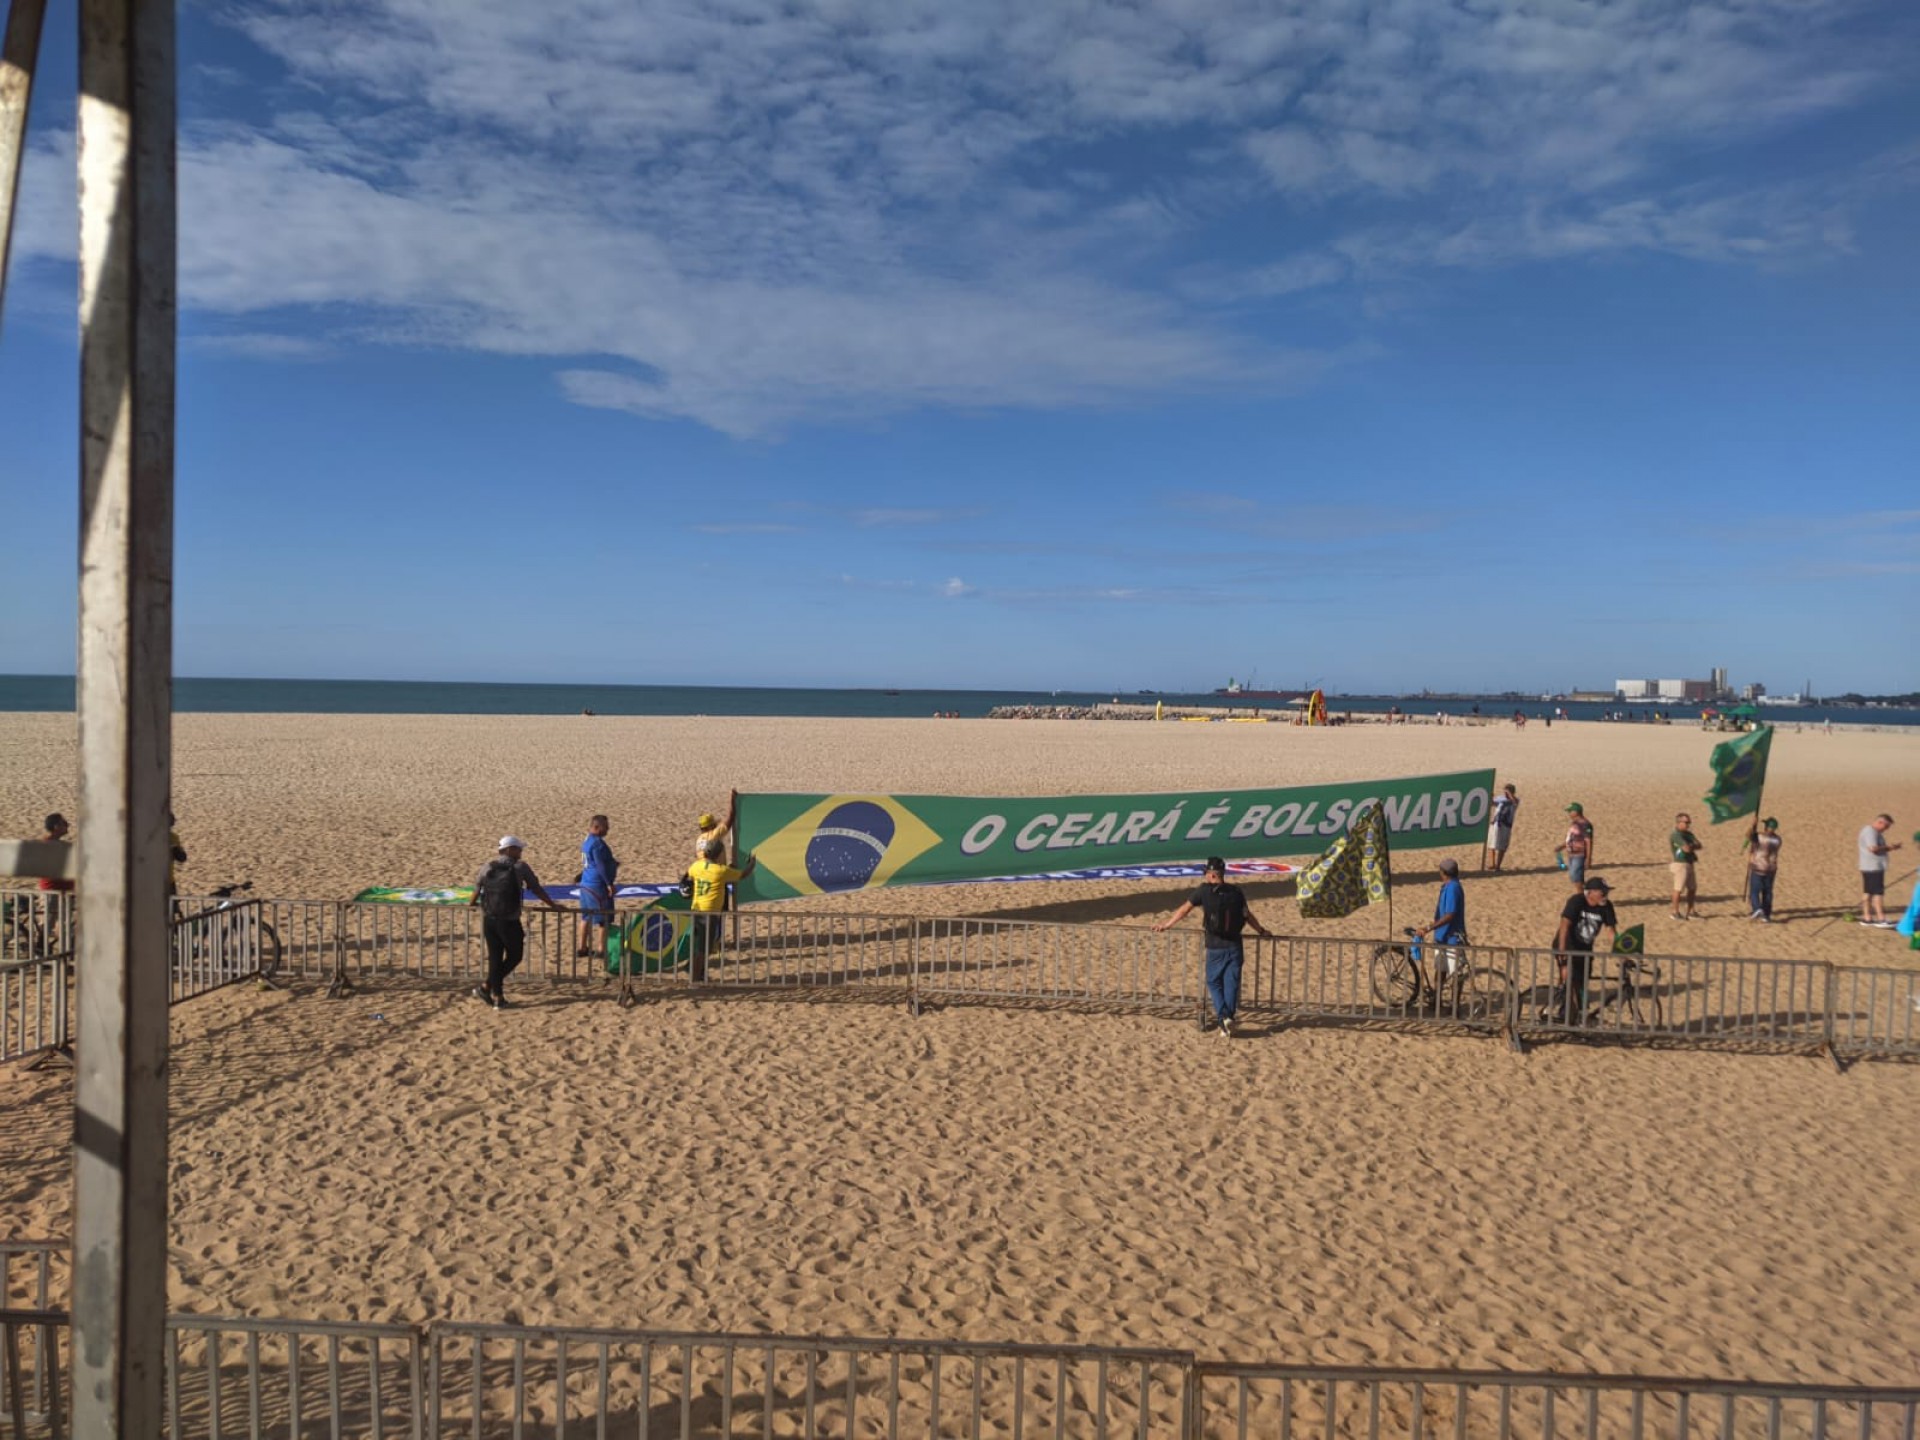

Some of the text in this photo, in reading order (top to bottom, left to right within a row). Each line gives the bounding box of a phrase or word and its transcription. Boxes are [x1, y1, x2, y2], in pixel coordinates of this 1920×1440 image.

[961, 787, 1489, 855] O CEARÁ É BOLSONARO
